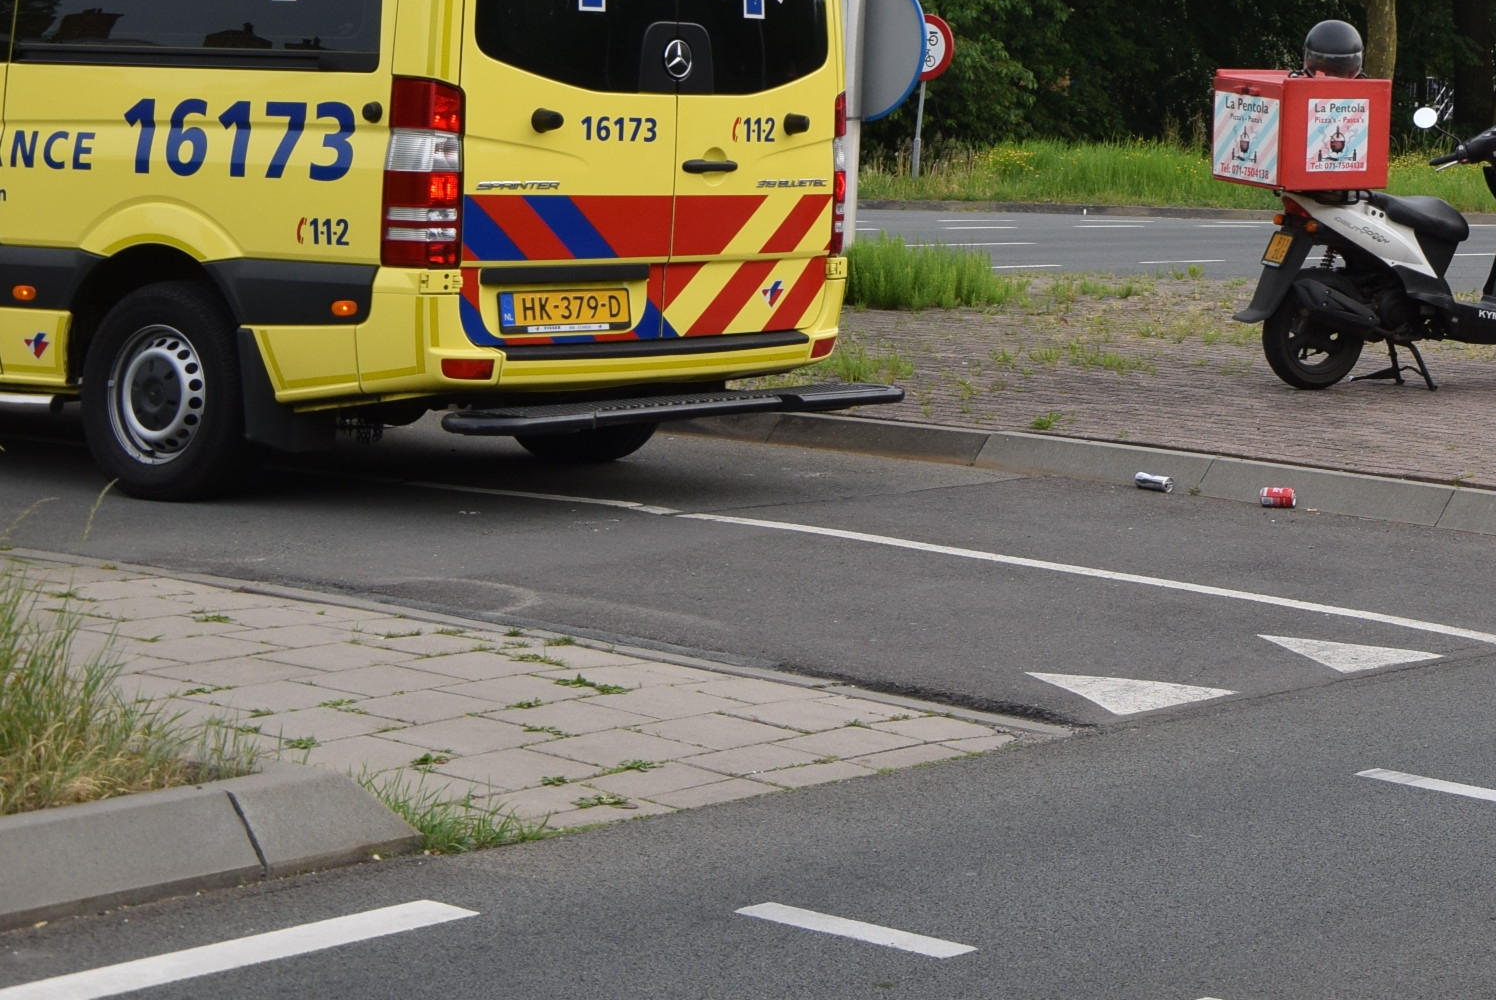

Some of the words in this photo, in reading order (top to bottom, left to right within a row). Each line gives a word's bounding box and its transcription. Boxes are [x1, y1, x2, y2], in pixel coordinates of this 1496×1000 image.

[1225, 95, 1235, 110] La
[1237, 97, 1269, 115] Pentola
[1314, 103, 1326, 113] La
[1329, 102, 1366, 113] Pentola
[1229, 112, 1245, 122] Pizza's
[1247, 114, 1263, 124] Pasta's
[1314, 116, 1336, 124] Pizza's
[1342, 116, 1365, 124] Pasta's
[580, 115, 657, 143] 16173
[0, 129, 96, 171] NCE
[124, 97, 356, 182] 16173
[1219, 162, 1231, 174] Tel:
[1231, 165, 1269, 180] 071-7504138
[1310, 162, 1323, 170] Tel:
[1324, 162, 1365, 170] 071-7504138
[476, 180, 560, 191] SPRINTER
[756, 179, 778, 189] 319
[777, 178, 829, 188] BLUETEC
[521, 294, 621, 321] HK-379-D
[503, 313, 514, 321] NL
